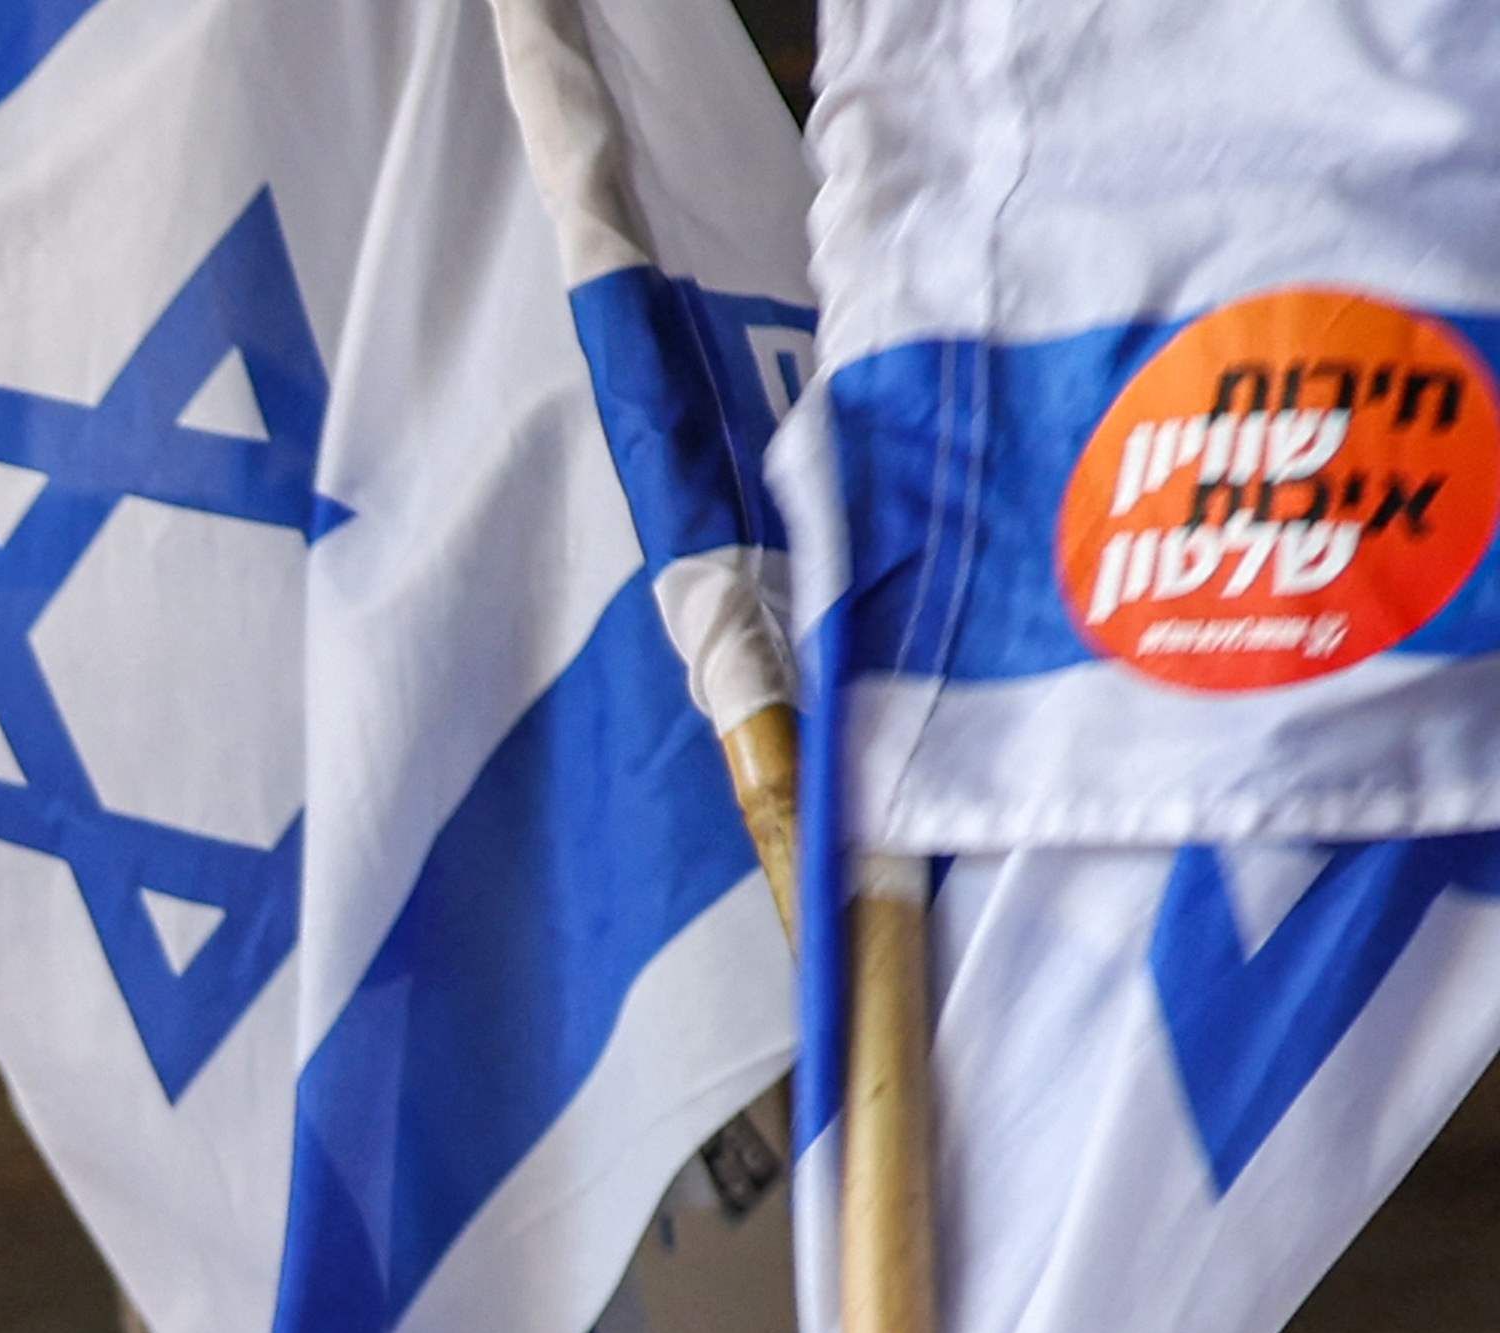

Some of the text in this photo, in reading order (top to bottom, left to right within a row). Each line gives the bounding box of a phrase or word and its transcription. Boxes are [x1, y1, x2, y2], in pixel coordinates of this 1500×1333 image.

[1209, 358, 1463, 428] חירות
[1109, 408, 1353, 517] שוויון
[1186, 476, 1446, 536] איכות
[1086, 507, 1364, 626] שלטון
